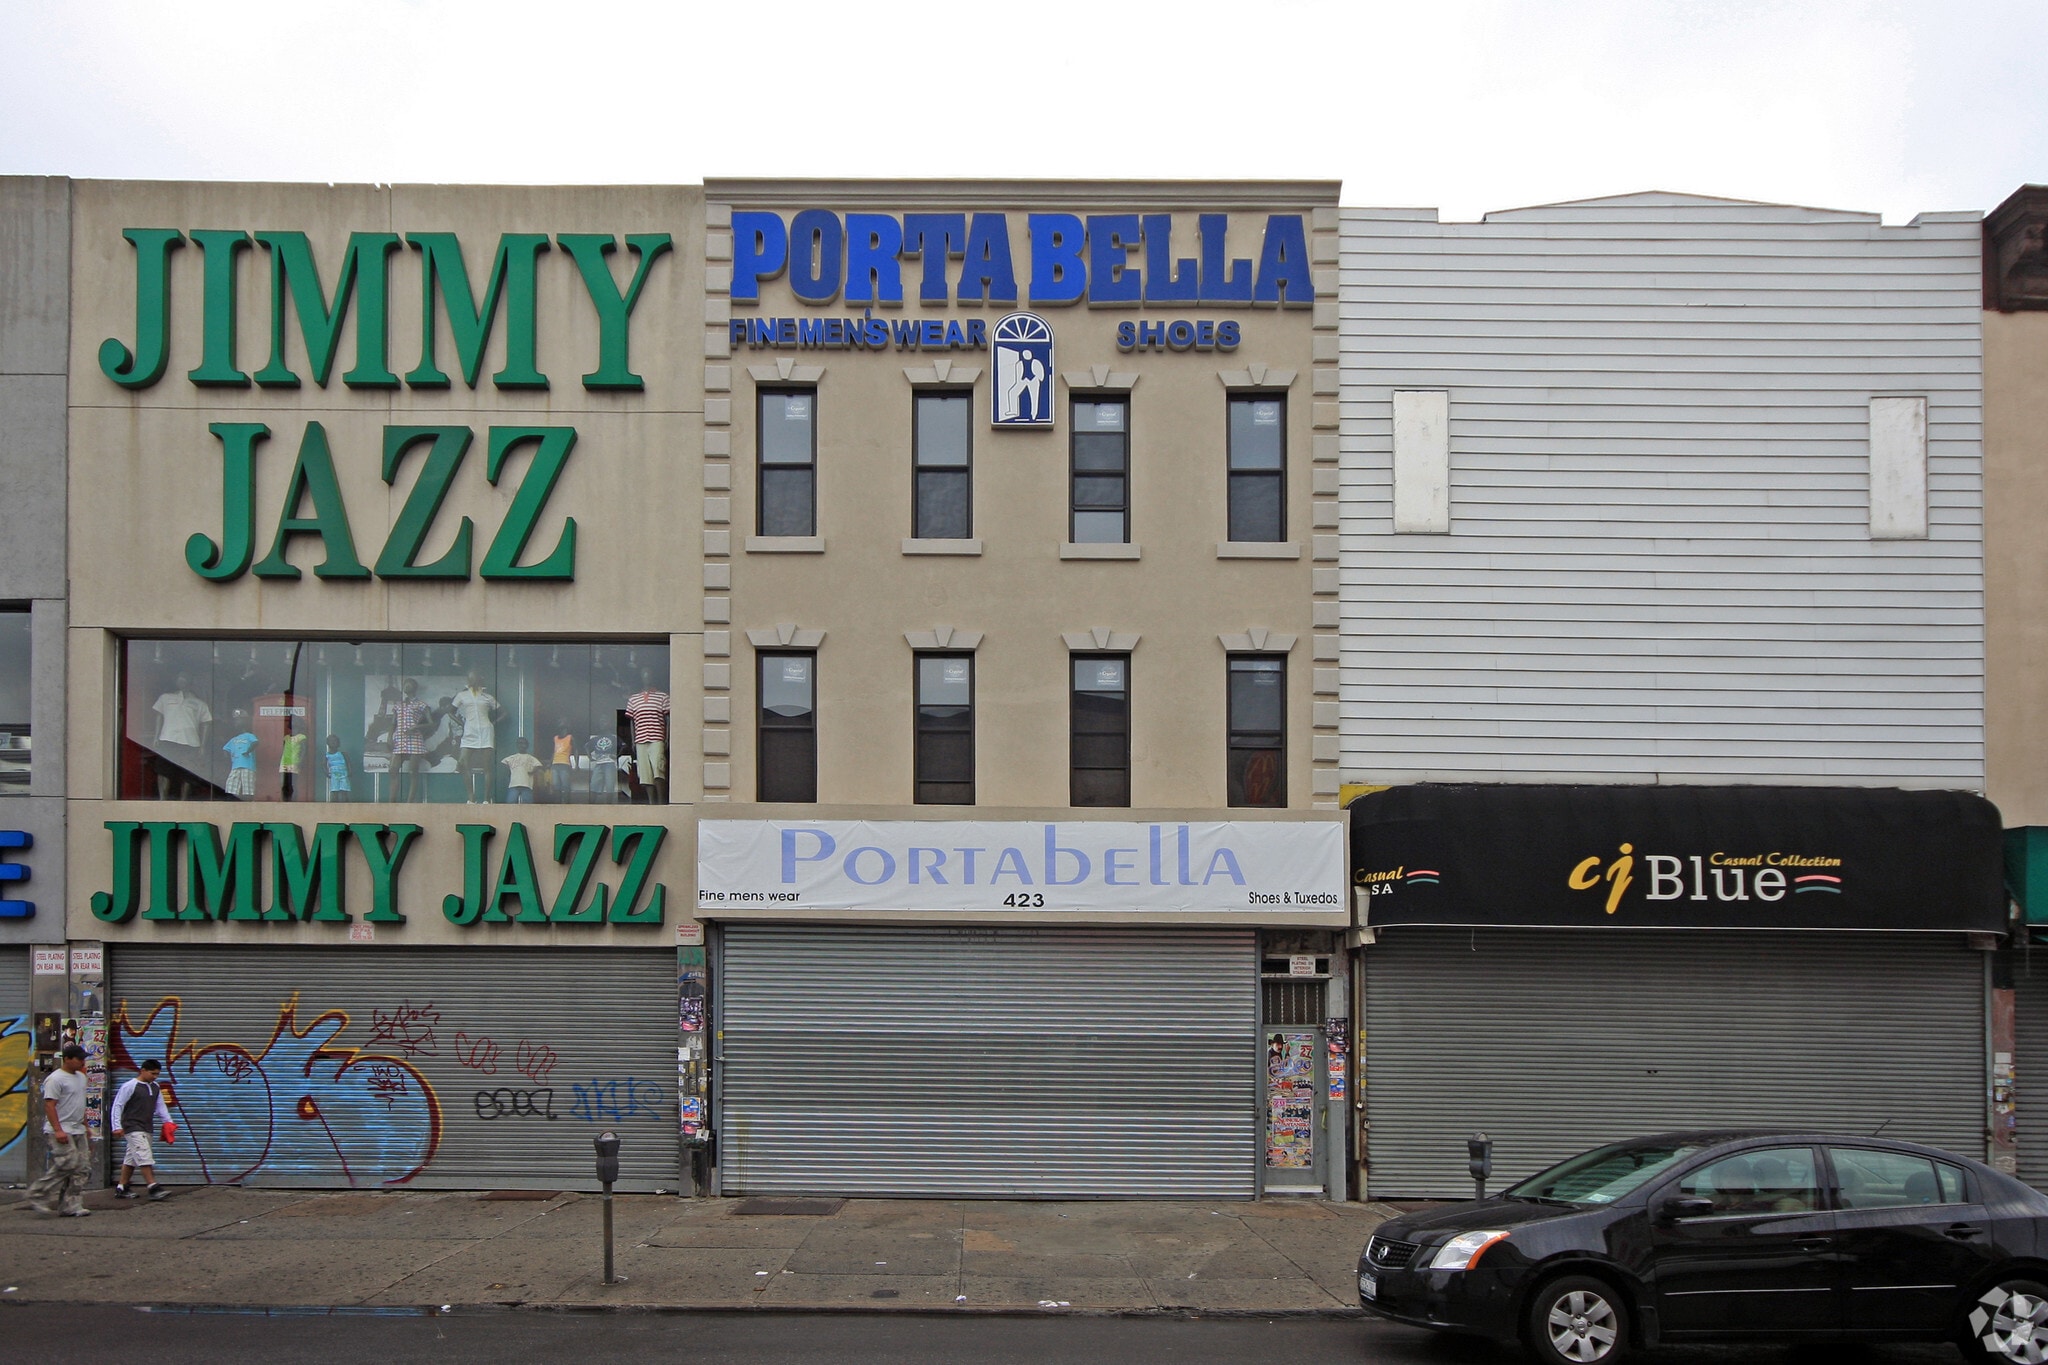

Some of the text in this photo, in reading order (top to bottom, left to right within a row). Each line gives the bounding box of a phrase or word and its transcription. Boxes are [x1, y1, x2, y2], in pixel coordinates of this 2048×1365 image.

[730, 208, 1315, 309] PORTA BELLA
[99, 228, 674, 391] JIMMY
[729, 317, 798, 349] FINE
[890, 319, 987, 351] WEAR
[1116, 319, 1242, 353] SHOES
[185, 421, 578, 582] JAZZ
[1709, 852, 1841, 867] Casual Collection
[90, 820, 669, 927] JIMMY JAZZ
[1354, 866, 1404, 883] Casual
[1645, 855, 1787, 901] Blue
[699, 890, 801, 901] Fine mens wear
[1003, 893, 1044, 907] 423
[1249, 891, 1338, 904] Shoes & Tuxedos
[73, 952, 101, 960] STEEL PLATING
[37, 963, 65, 971] ON REAR WALL
[73, 962, 101, 970] ON REAR WALL
